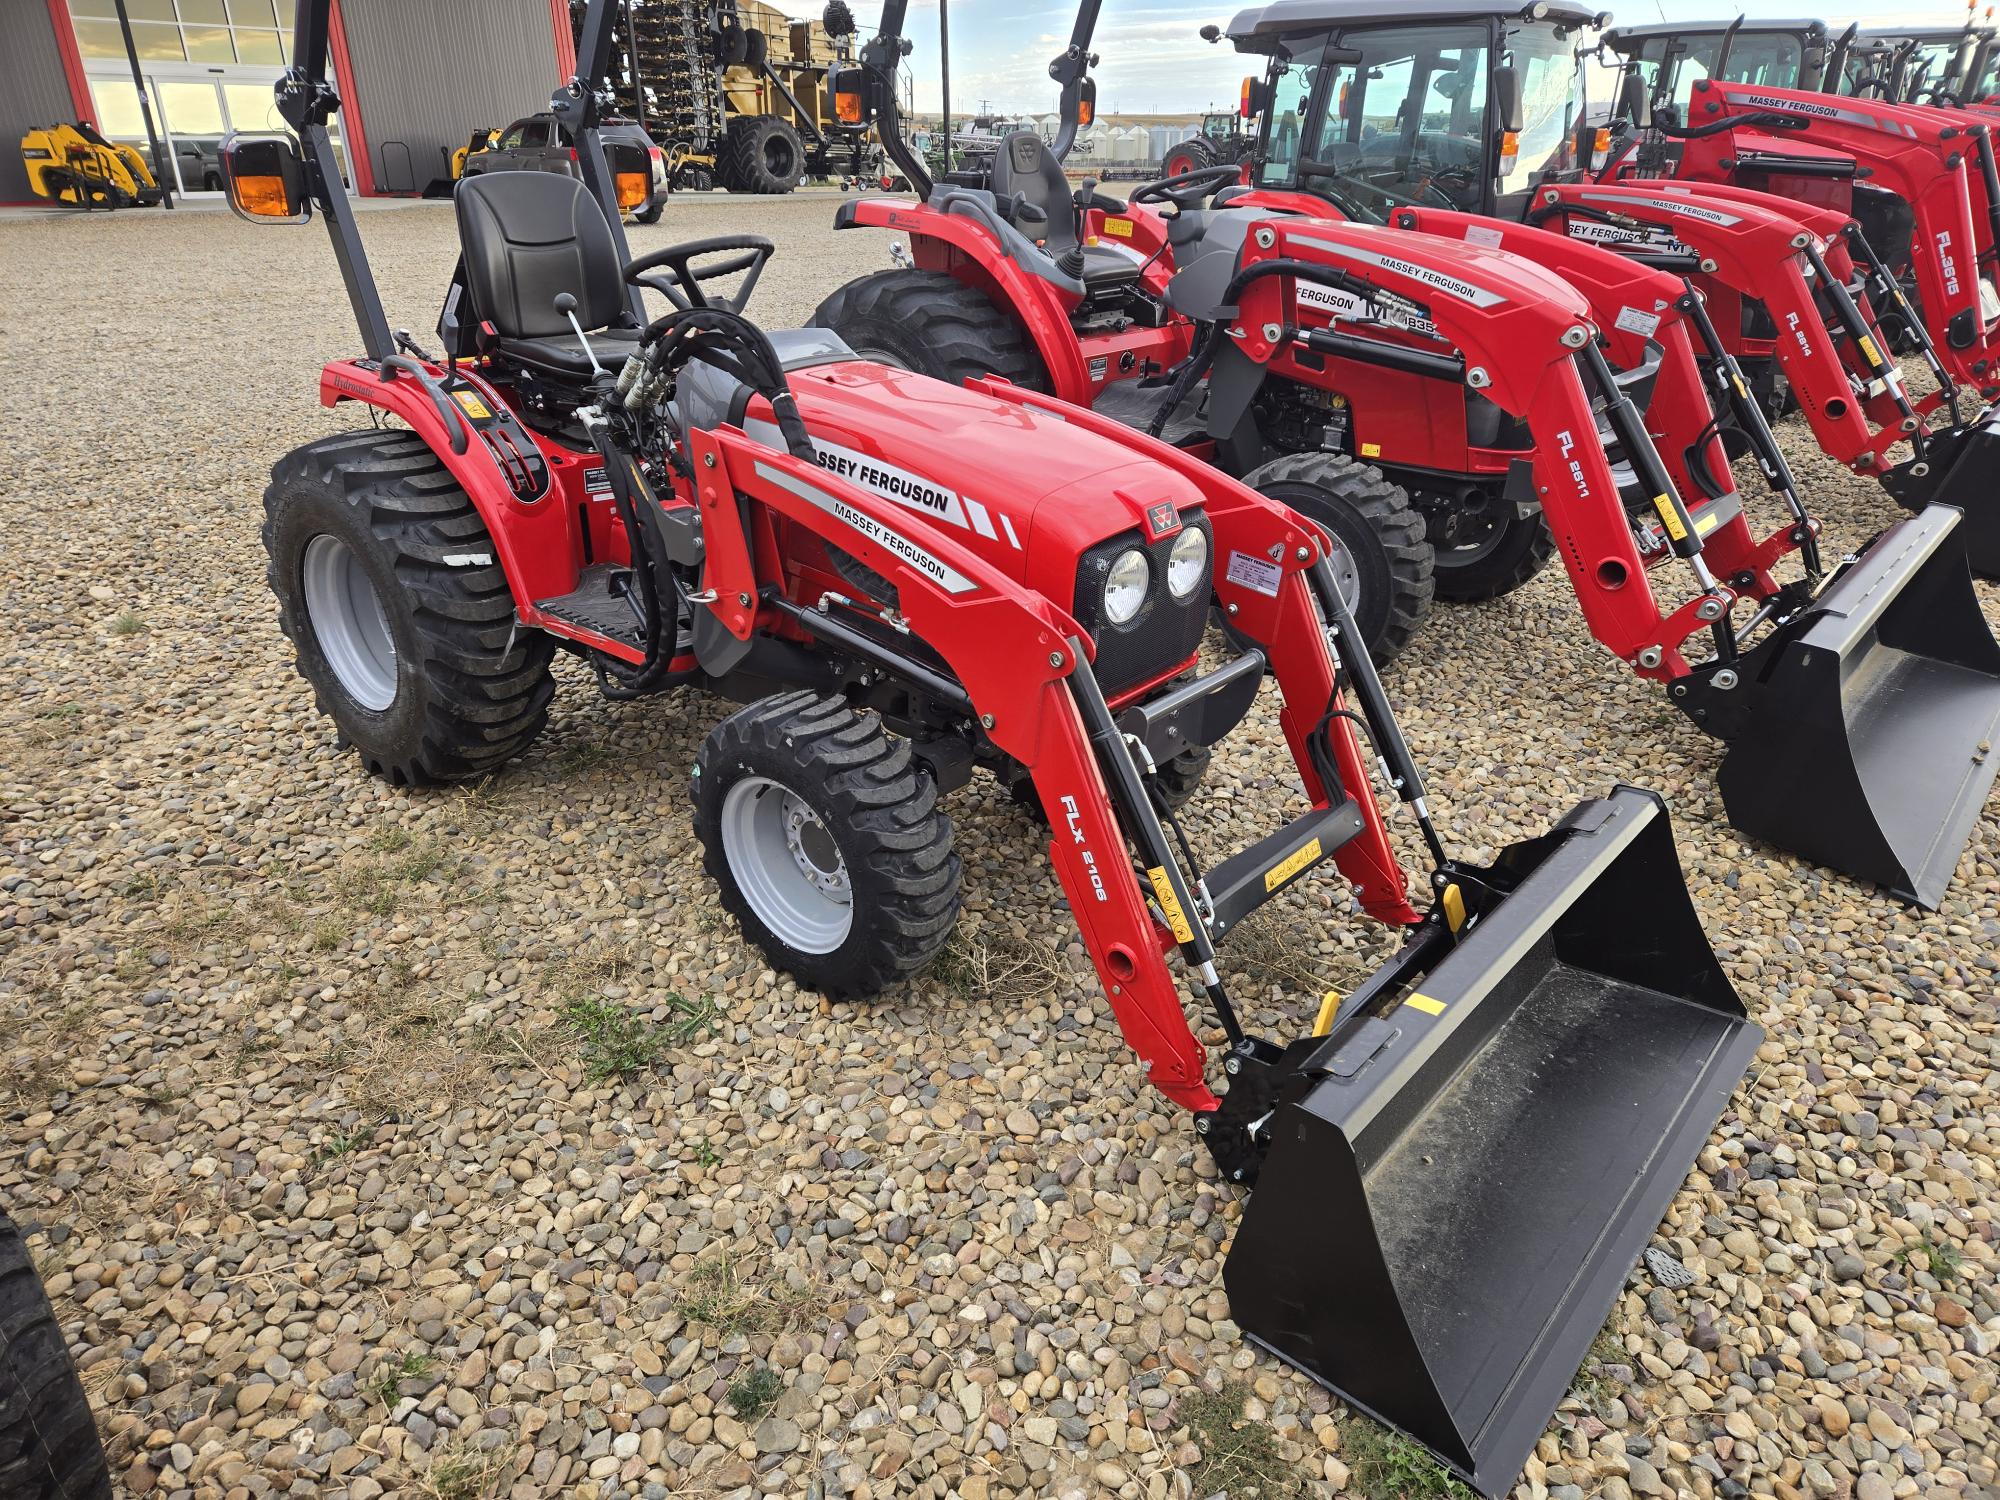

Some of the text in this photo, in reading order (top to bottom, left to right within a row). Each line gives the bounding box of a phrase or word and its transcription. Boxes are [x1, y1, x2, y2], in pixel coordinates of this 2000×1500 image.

[1748, 96, 1838, 117] MASSEY FERGUSON
[1652, 200, 1722, 221] MASSEY FERGUSON
[1569, 224, 1642, 241] SEY FERGUSO
[1380, 257, 1476, 298] MASSEY FERGUSON
[1296, 287, 1354, 310] FERGUSON
[1785, 311, 1800, 331] FL
[334, 374, 375, 397] Hydrostatic
[1556, 430, 1590, 498] FL 2611
[817, 451, 949, 513] SSEY FERGUSON
[834, 502, 946, 580] MASSEY FERGUSON
[1060, 795, 1108, 902] FLX 2106
